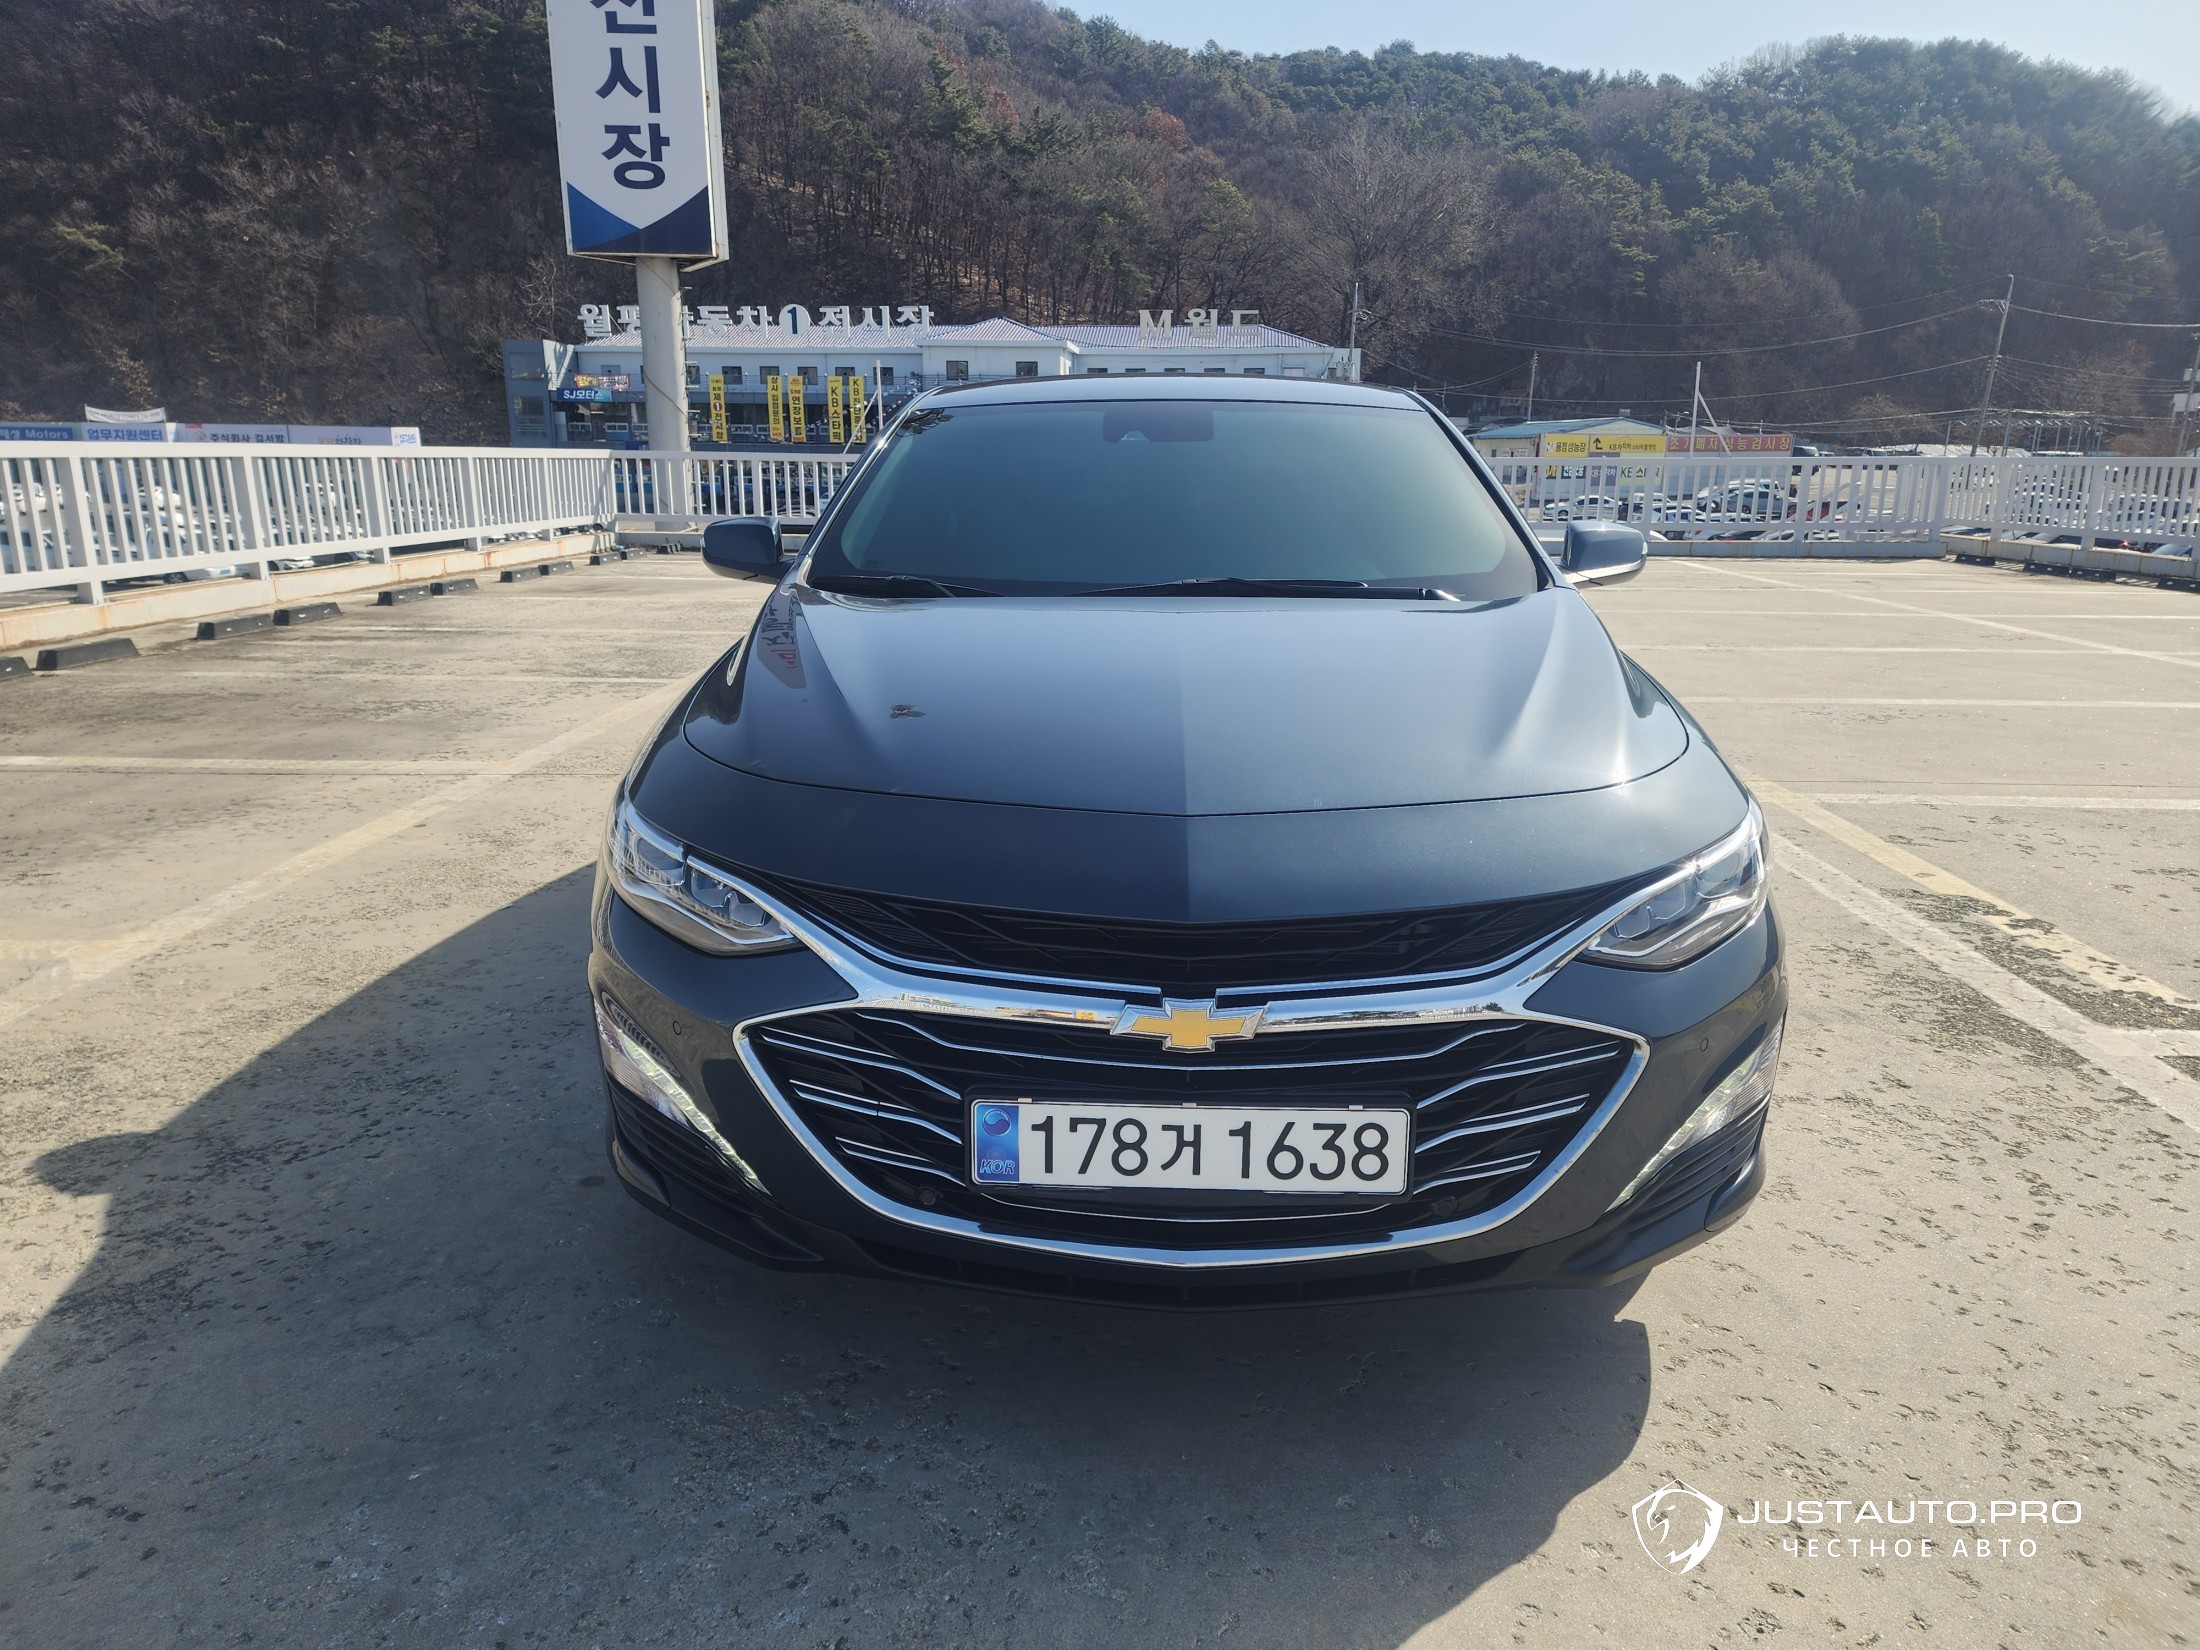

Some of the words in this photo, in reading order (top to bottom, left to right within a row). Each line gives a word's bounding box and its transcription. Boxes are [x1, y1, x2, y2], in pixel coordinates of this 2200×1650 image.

[577, 303, 936, 340] 월평동차1전시장
[771, 376, 779, 391] 상사
[563, 390, 604, 400] SJ모터스
[25, 429, 69, 440] Motors
[87, 428, 163, 441] 업무지원센터
[1031, 1115, 1201, 1176] 178거
[1228, 1121, 1389, 1181] 1638
[979, 1158, 1016, 1174] KOR
